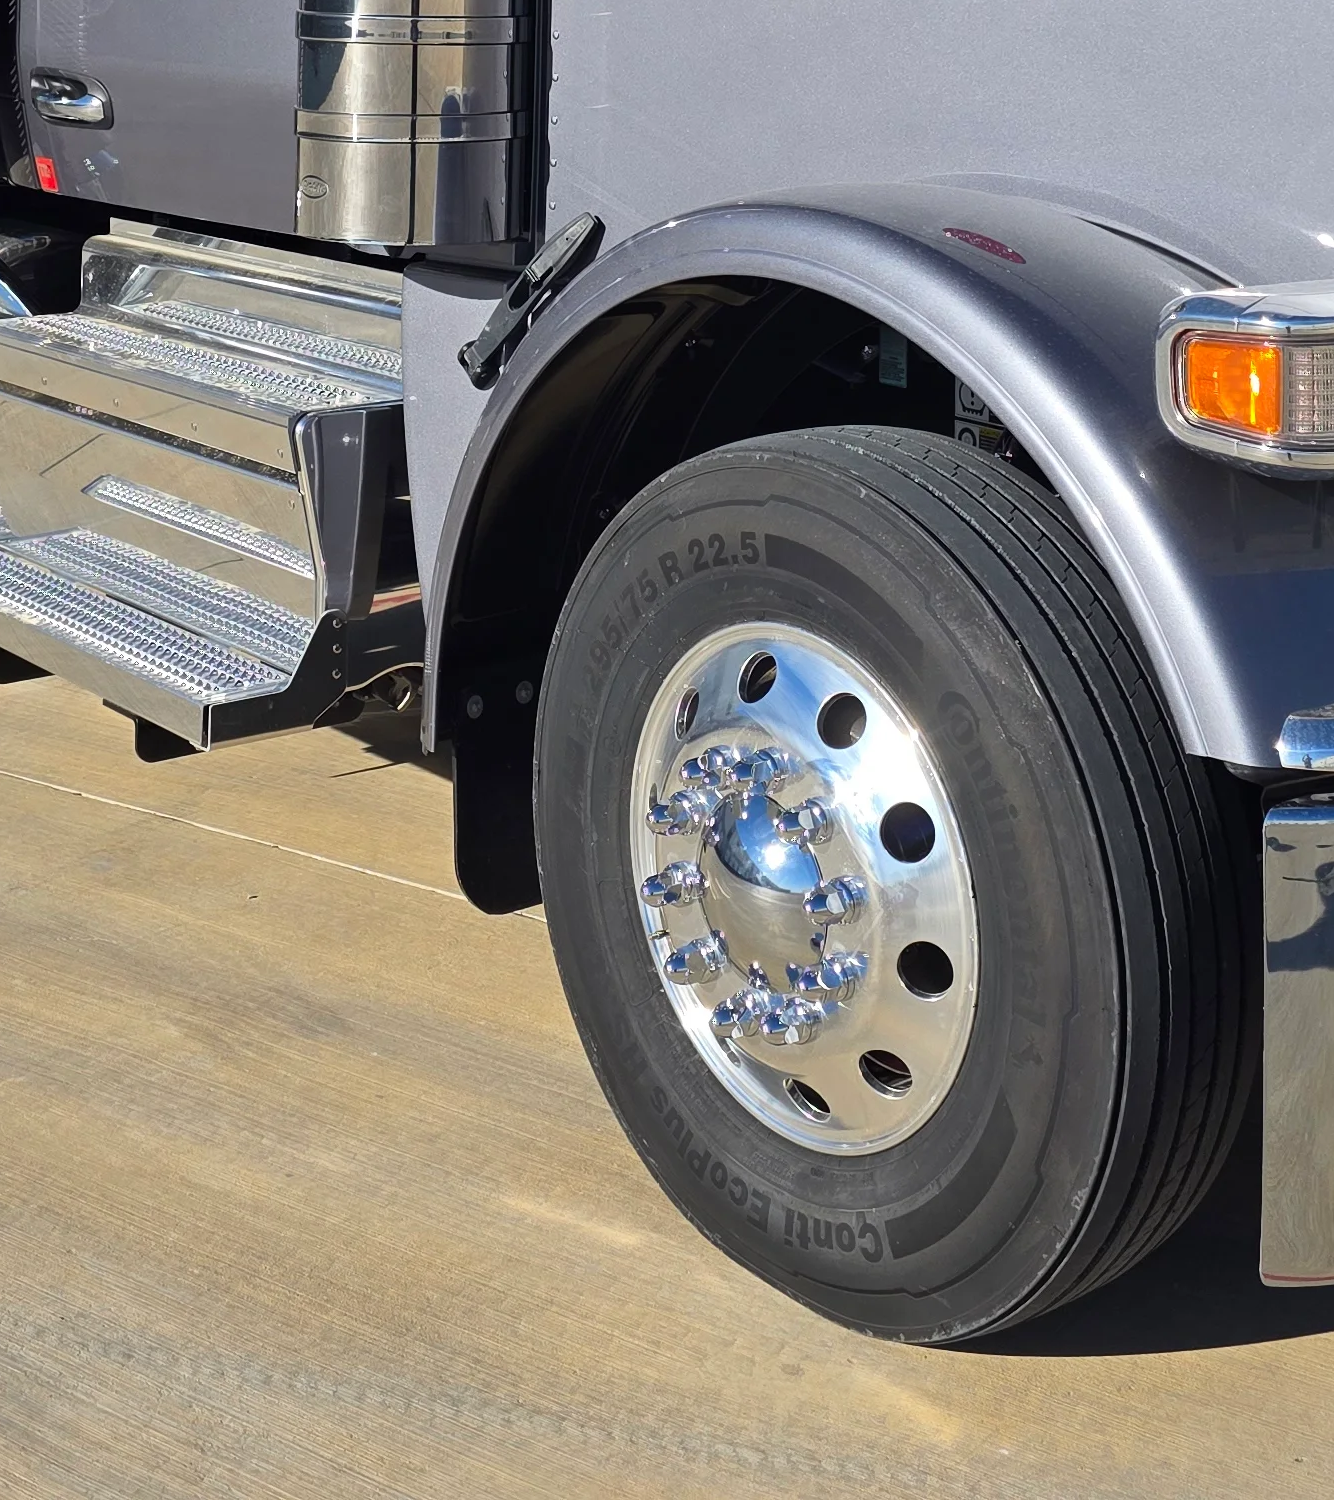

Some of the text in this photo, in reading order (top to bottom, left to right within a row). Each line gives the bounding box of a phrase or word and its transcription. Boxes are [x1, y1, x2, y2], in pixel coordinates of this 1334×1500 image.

[657, 551, 685, 588] R
[687, 530, 760, 573] 22.5
[650, 1085, 773, 1233] EcoPlus
[783, 1206, 885, 1264] Conti
